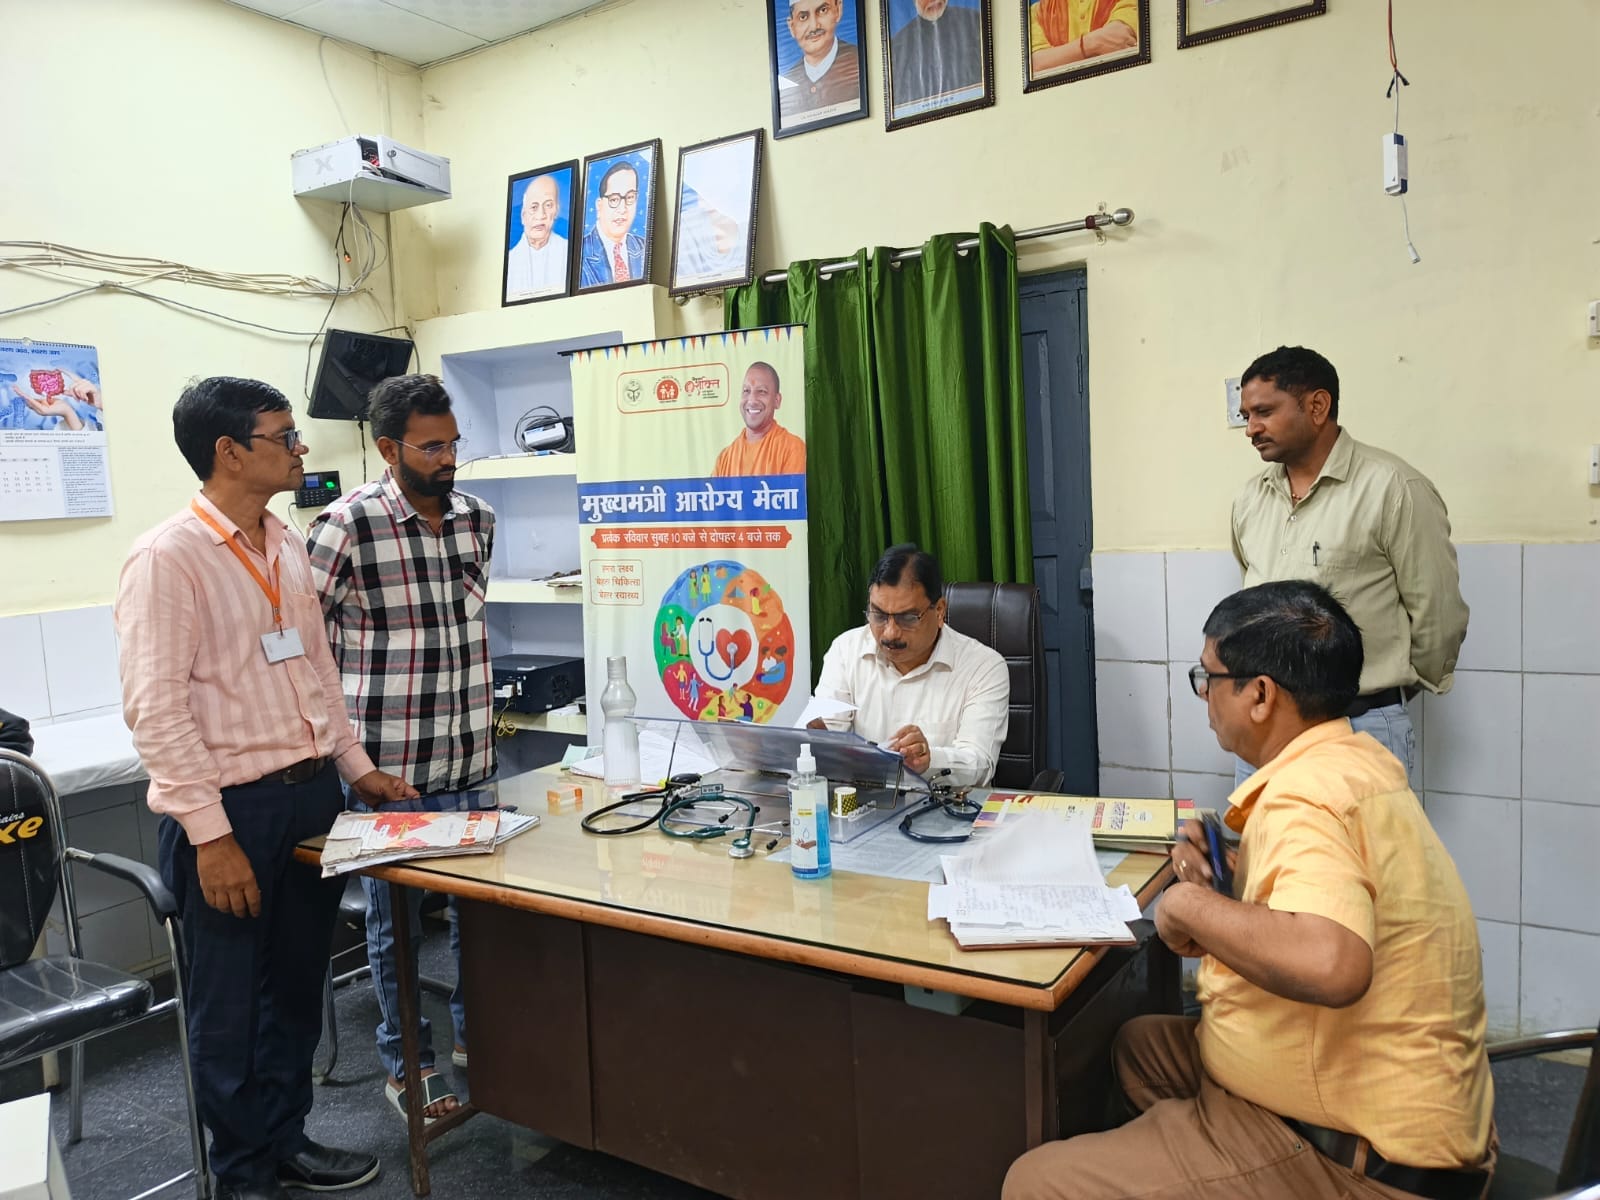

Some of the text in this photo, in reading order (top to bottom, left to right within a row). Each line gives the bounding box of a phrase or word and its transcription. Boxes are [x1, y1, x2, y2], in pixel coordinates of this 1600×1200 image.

[581, 480, 799, 522] मुख्यमंत्री आरोग्य मेला
[624, 530, 649, 544] रविवार
[671, 533, 680, 544] 10
[700, 530, 708, 543] से
[710, 530, 736, 543] दोपहर
[738, 533, 744, 543] 4
[765, 531, 781, 542] तक
